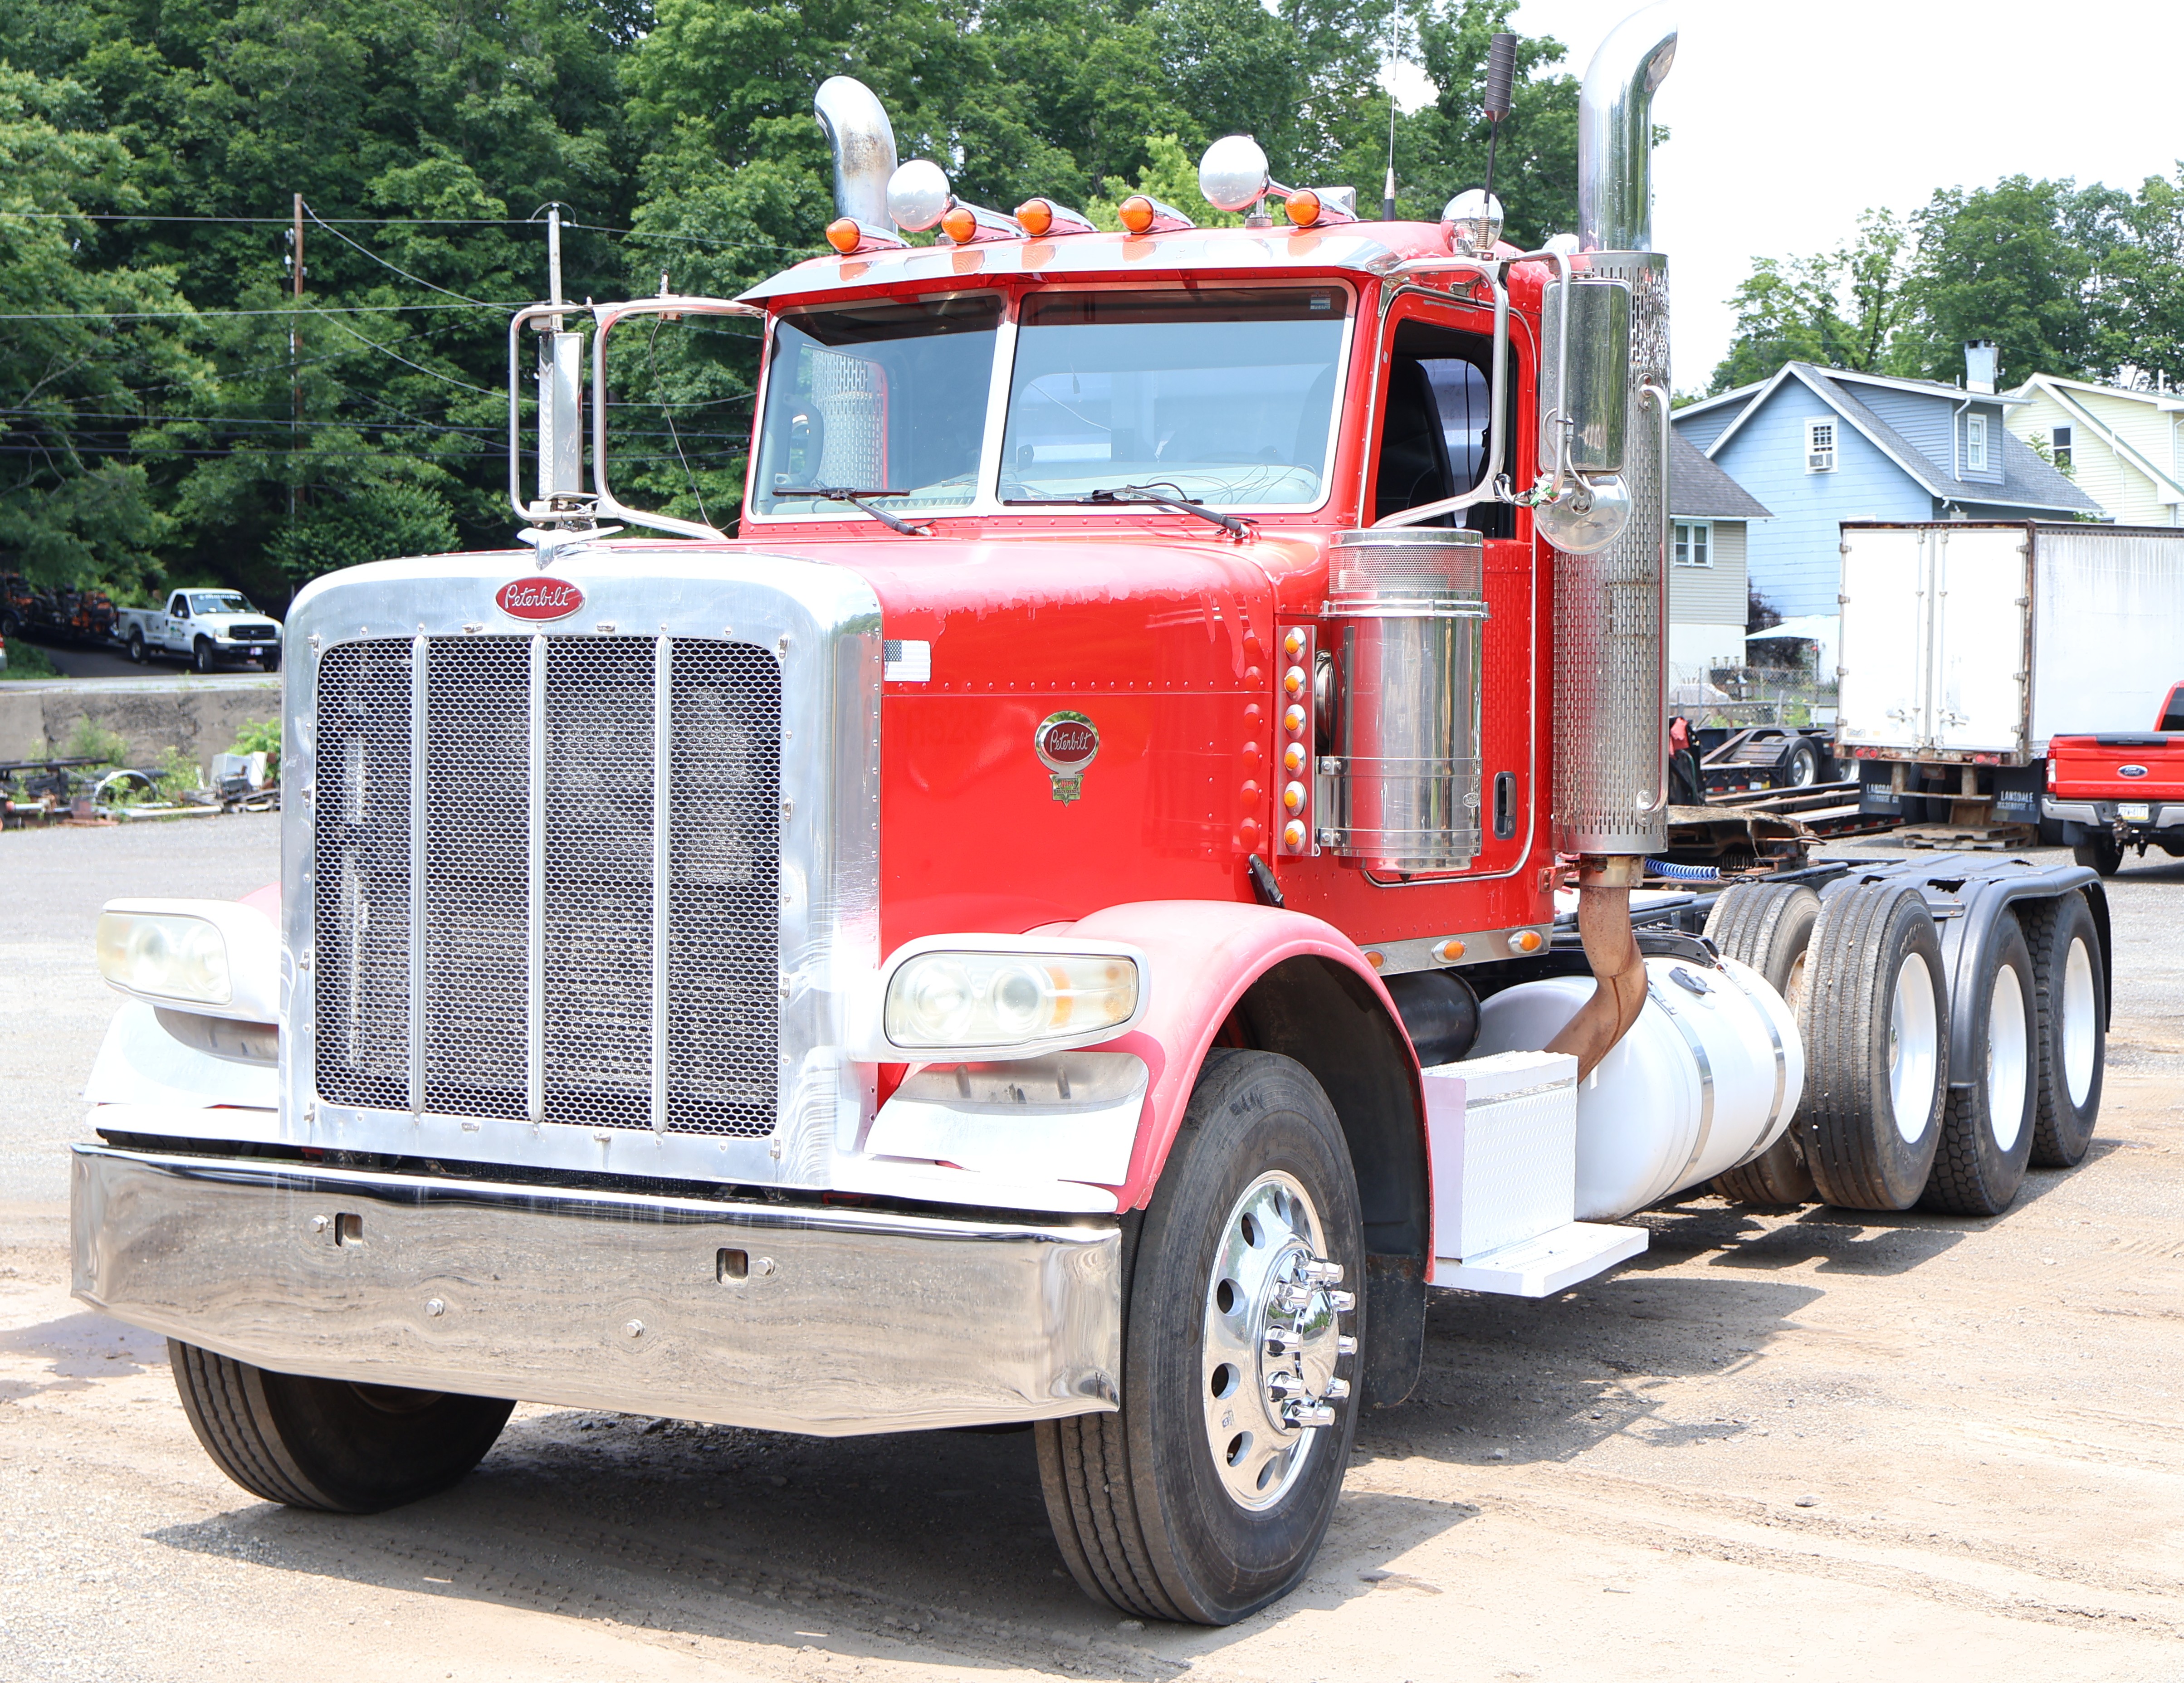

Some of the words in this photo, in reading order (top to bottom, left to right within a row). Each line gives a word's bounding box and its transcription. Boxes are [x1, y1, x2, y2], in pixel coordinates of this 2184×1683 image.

[505, 584, 576, 609] Peterbilt
[1050, 729, 1092, 753] Peterbilt
[2000, 790, 2034, 803] LANSDALE
